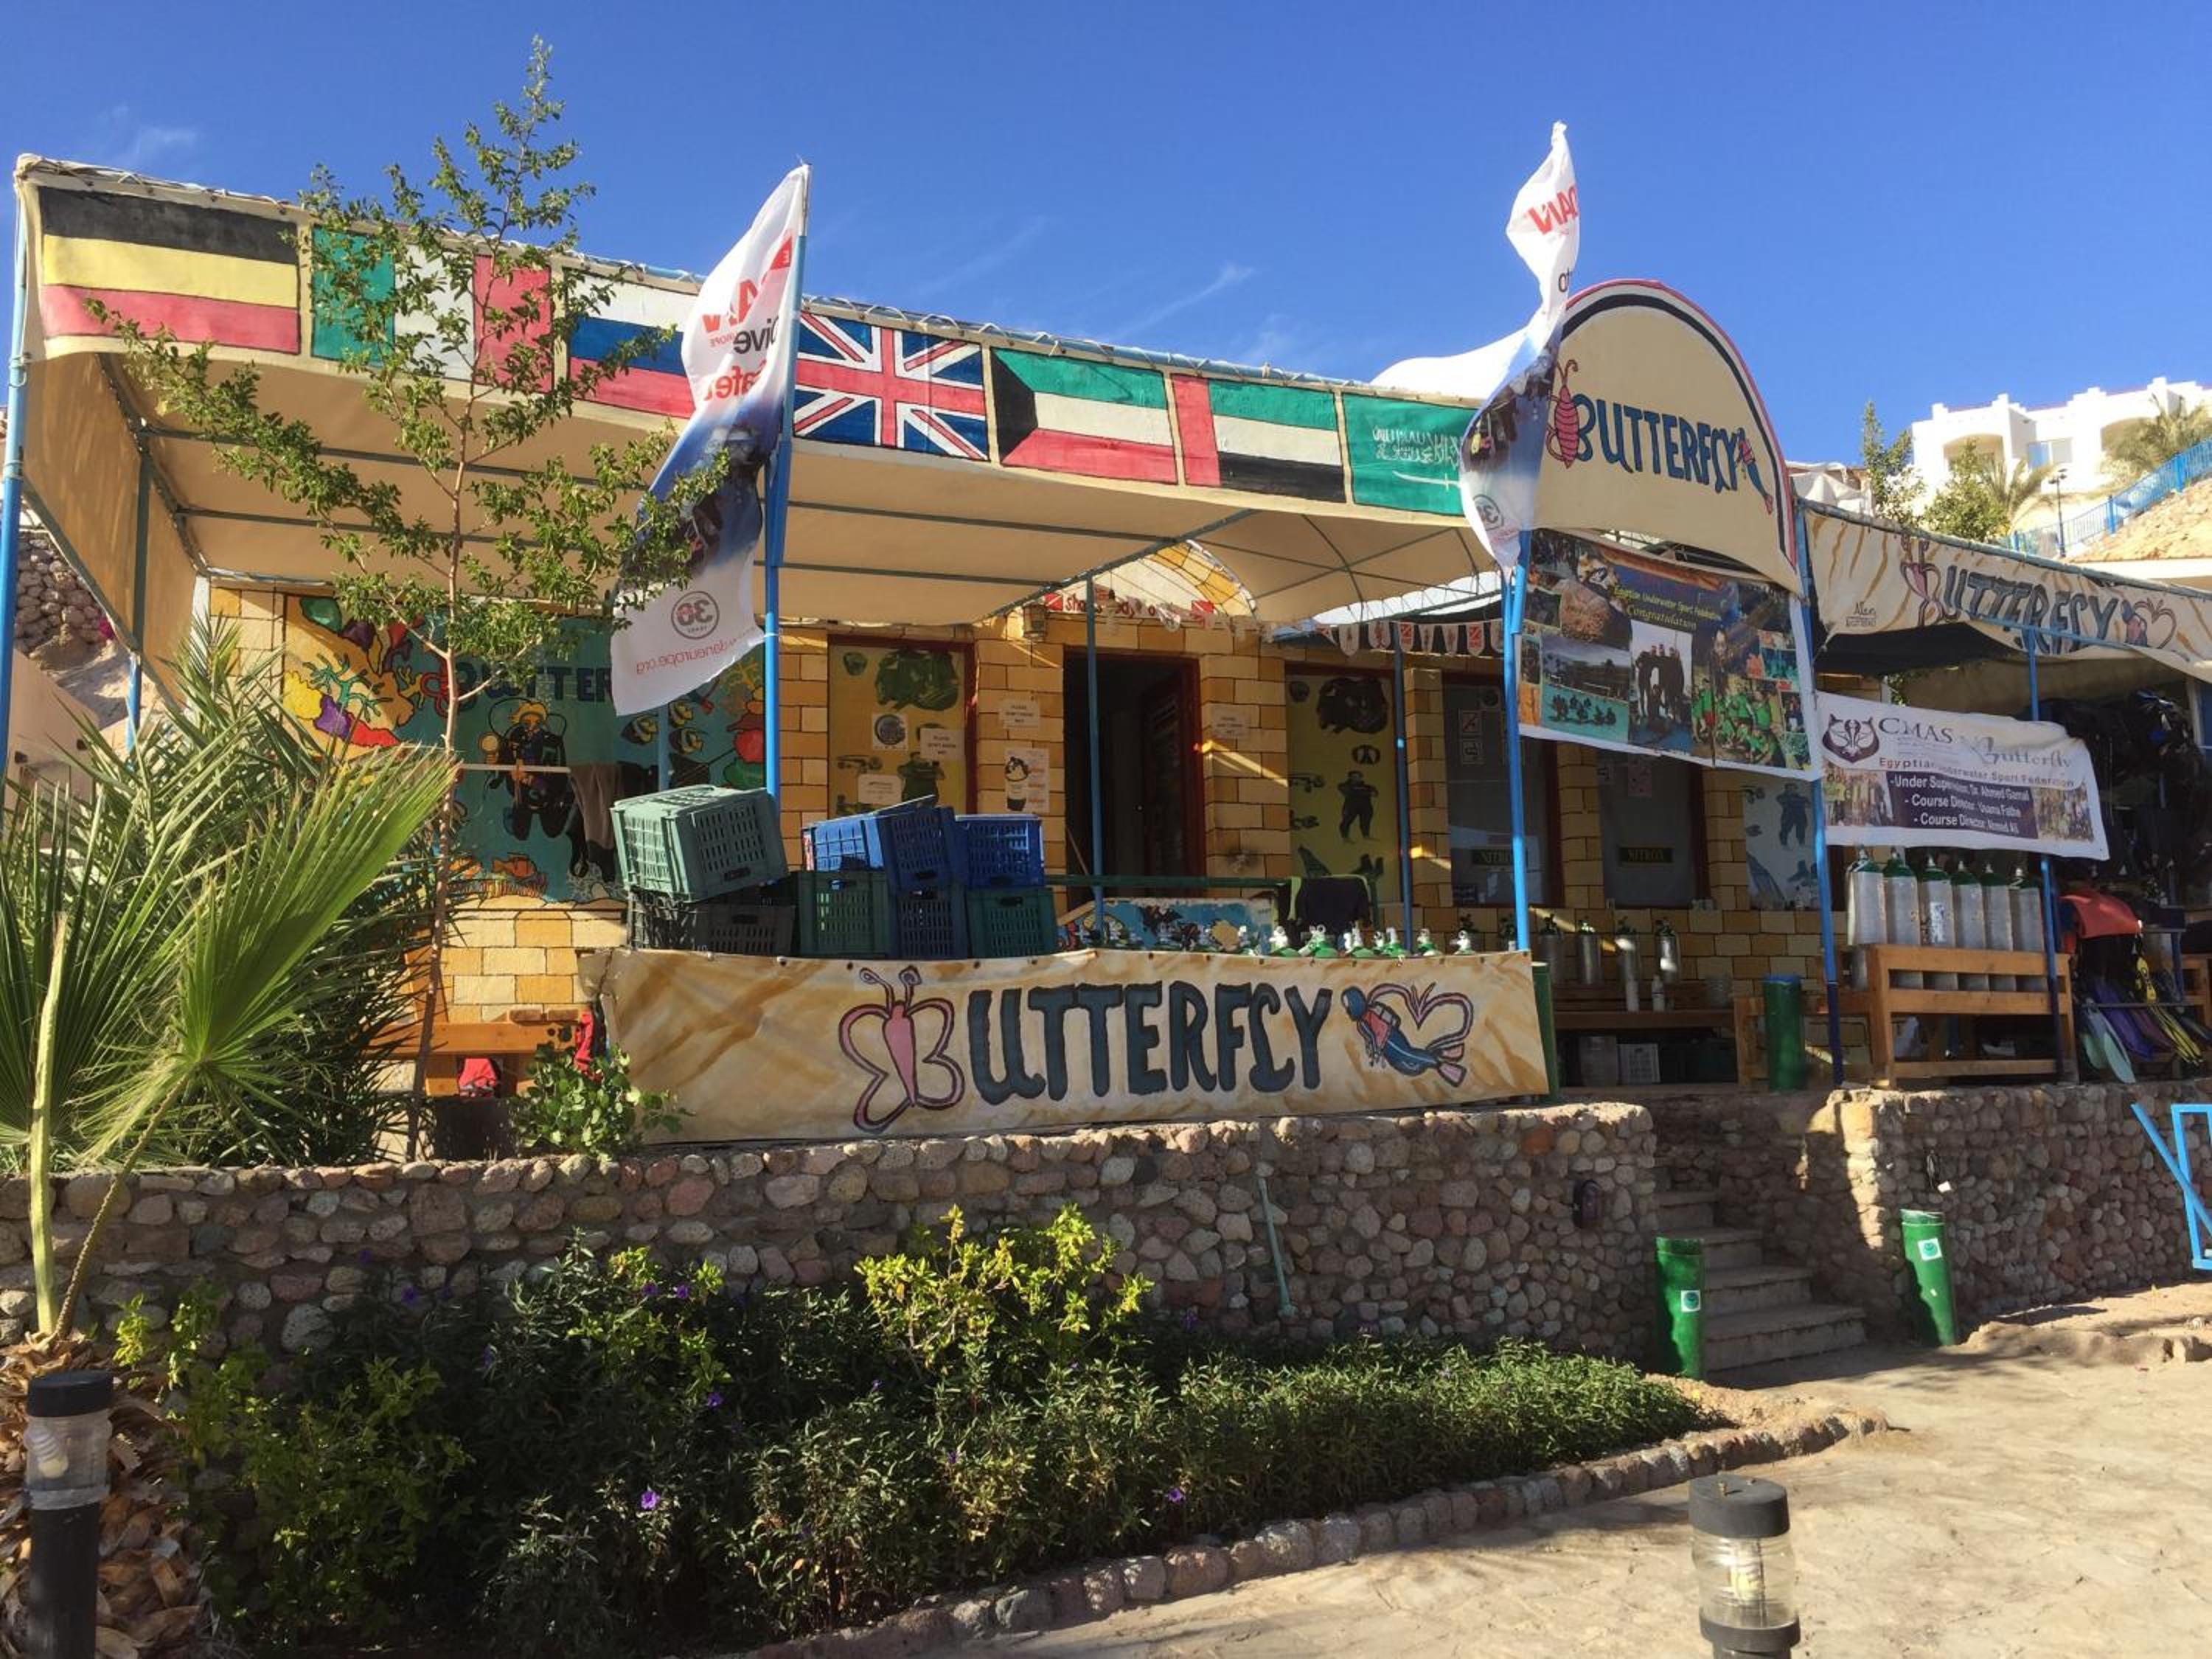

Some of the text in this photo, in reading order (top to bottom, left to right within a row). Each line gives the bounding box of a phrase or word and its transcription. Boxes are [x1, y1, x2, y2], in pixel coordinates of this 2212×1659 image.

[1878, 717, 1954, 744] CMAS
[1912, 793, 1949, 807] Course
[1920, 813, 1958, 826] Course
